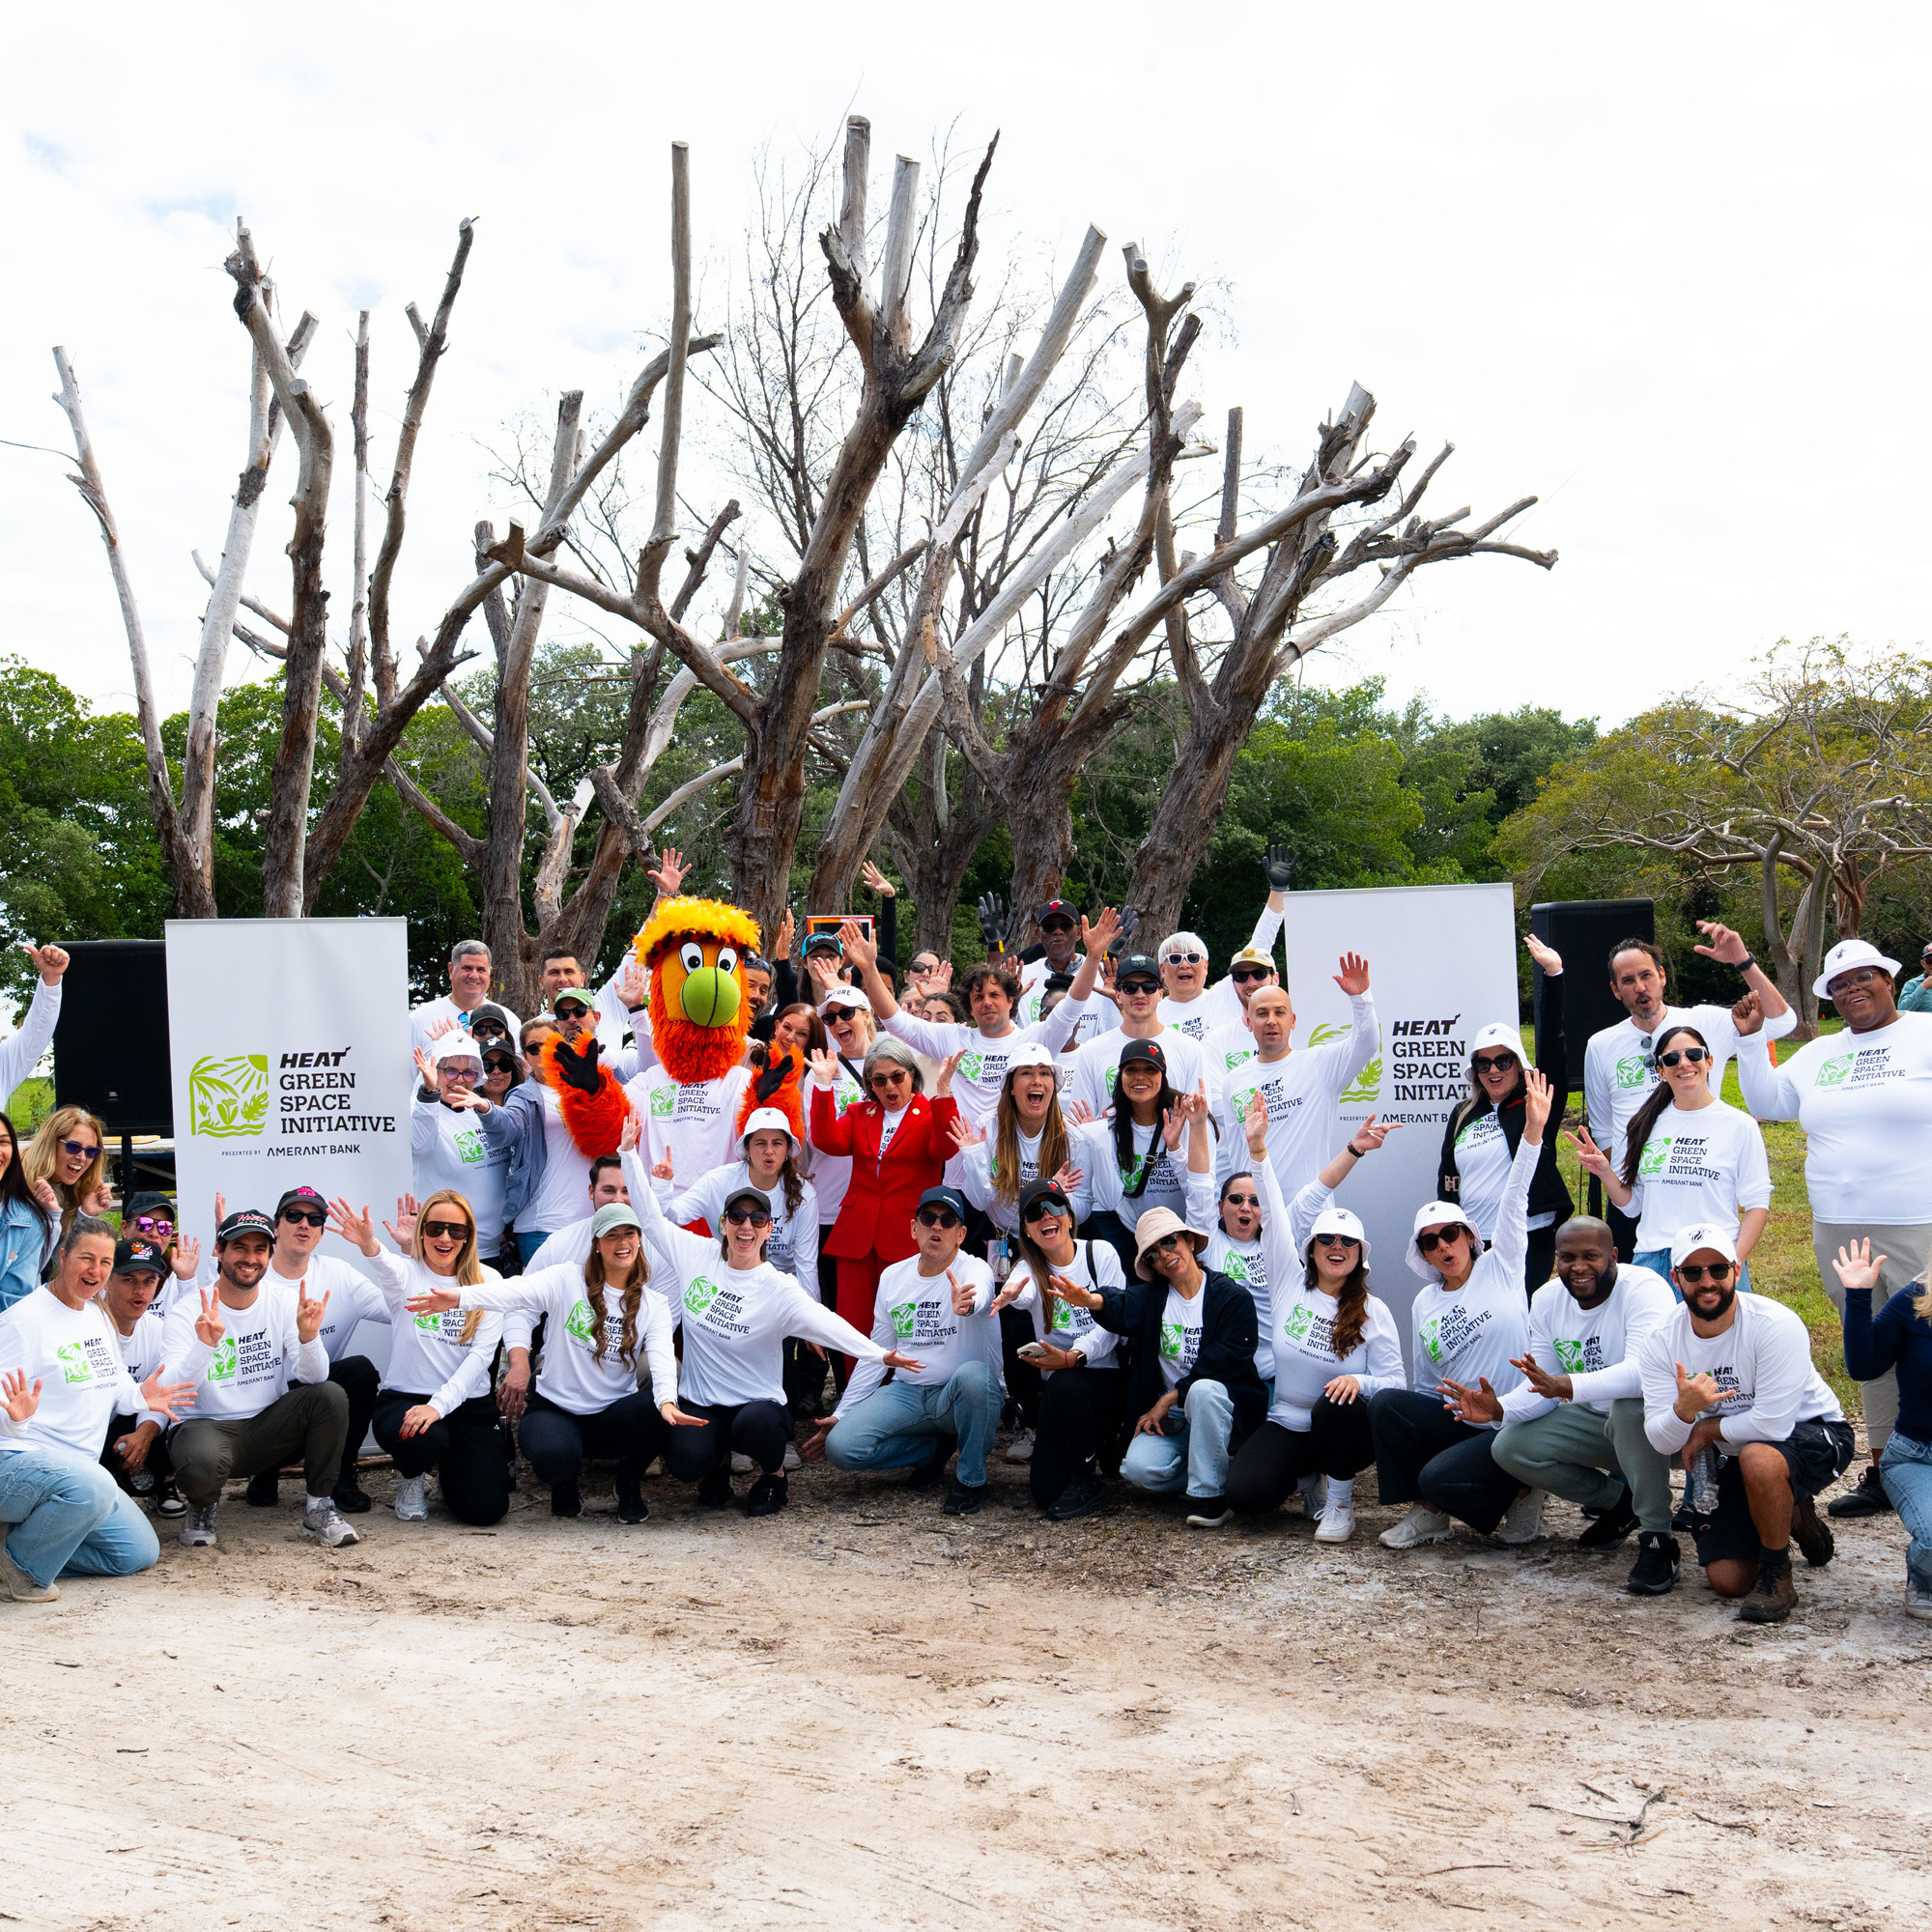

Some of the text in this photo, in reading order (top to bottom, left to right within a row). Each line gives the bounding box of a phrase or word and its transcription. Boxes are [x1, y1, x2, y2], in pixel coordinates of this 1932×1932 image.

[1392, 1013, 1461, 1037] HEAT
[1392, 1040, 1465, 1059] GREEN
[1858, 1045, 1892, 1058] HEAT
[279, 1045, 352, 1068] HEAT
[1856, 1055, 1890, 1066] GREEN
[1393, 1063, 1462, 1080] SPACE
[1850, 1069, 1906, 1082] INITIATIVE
[1853, 1064, 1886, 1074] SPACE
[279, 1072, 355, 1091] GREEN
[678, 1089, 709, 1097] GREEN
[1394, 1084, 1473, 1102] INITIAT
[280, 1094, 351, 1113] SPACE
[677, 1096, 705, 1105] SPACE
[677, 1104, 722, 1115] INITIATIVE
[1381, 1113, 1438, 1123] AMERANT
[280, 1116, 396, 1134] INITIATIVE
[1675, 1136, 1709, 1146] HEAT
[267, 1145, 327, 1157] AMERANT
[329, 1144, 361, 1154] BANK
[1672, 1146, 1708, 1155] GREEN
[1670, 1155, 1702, 1165] SPACE
[1668, 1165, 1720, 1180] INITIATIVE
[719, 1290, 746, 1303] HEAT
[714, 1297, 743, 1315] GREEN
[918, 1300, 943, 1309] HEAT
[709, 1304, 736, 1321] SPACE
[1072, 1307, 1091, 1318] SPA
[441, 1319, 466, 1327] SPAC
[705, 1312, 751, 1334] INITIATIVE
[1312, 1322, 1334, 1335] GREE
[238, 1327, 267, 1345] HEAT
[915, 1325, 957, 1338] INITIATIVE
[1309, 1329, 1332, 1344] SPAC
[1445, 1310, 1492, 1350] INITIATIVE
[239, 1340, 271, 1354] GREEN
[240, 1350, 271, 1365] SPACE
